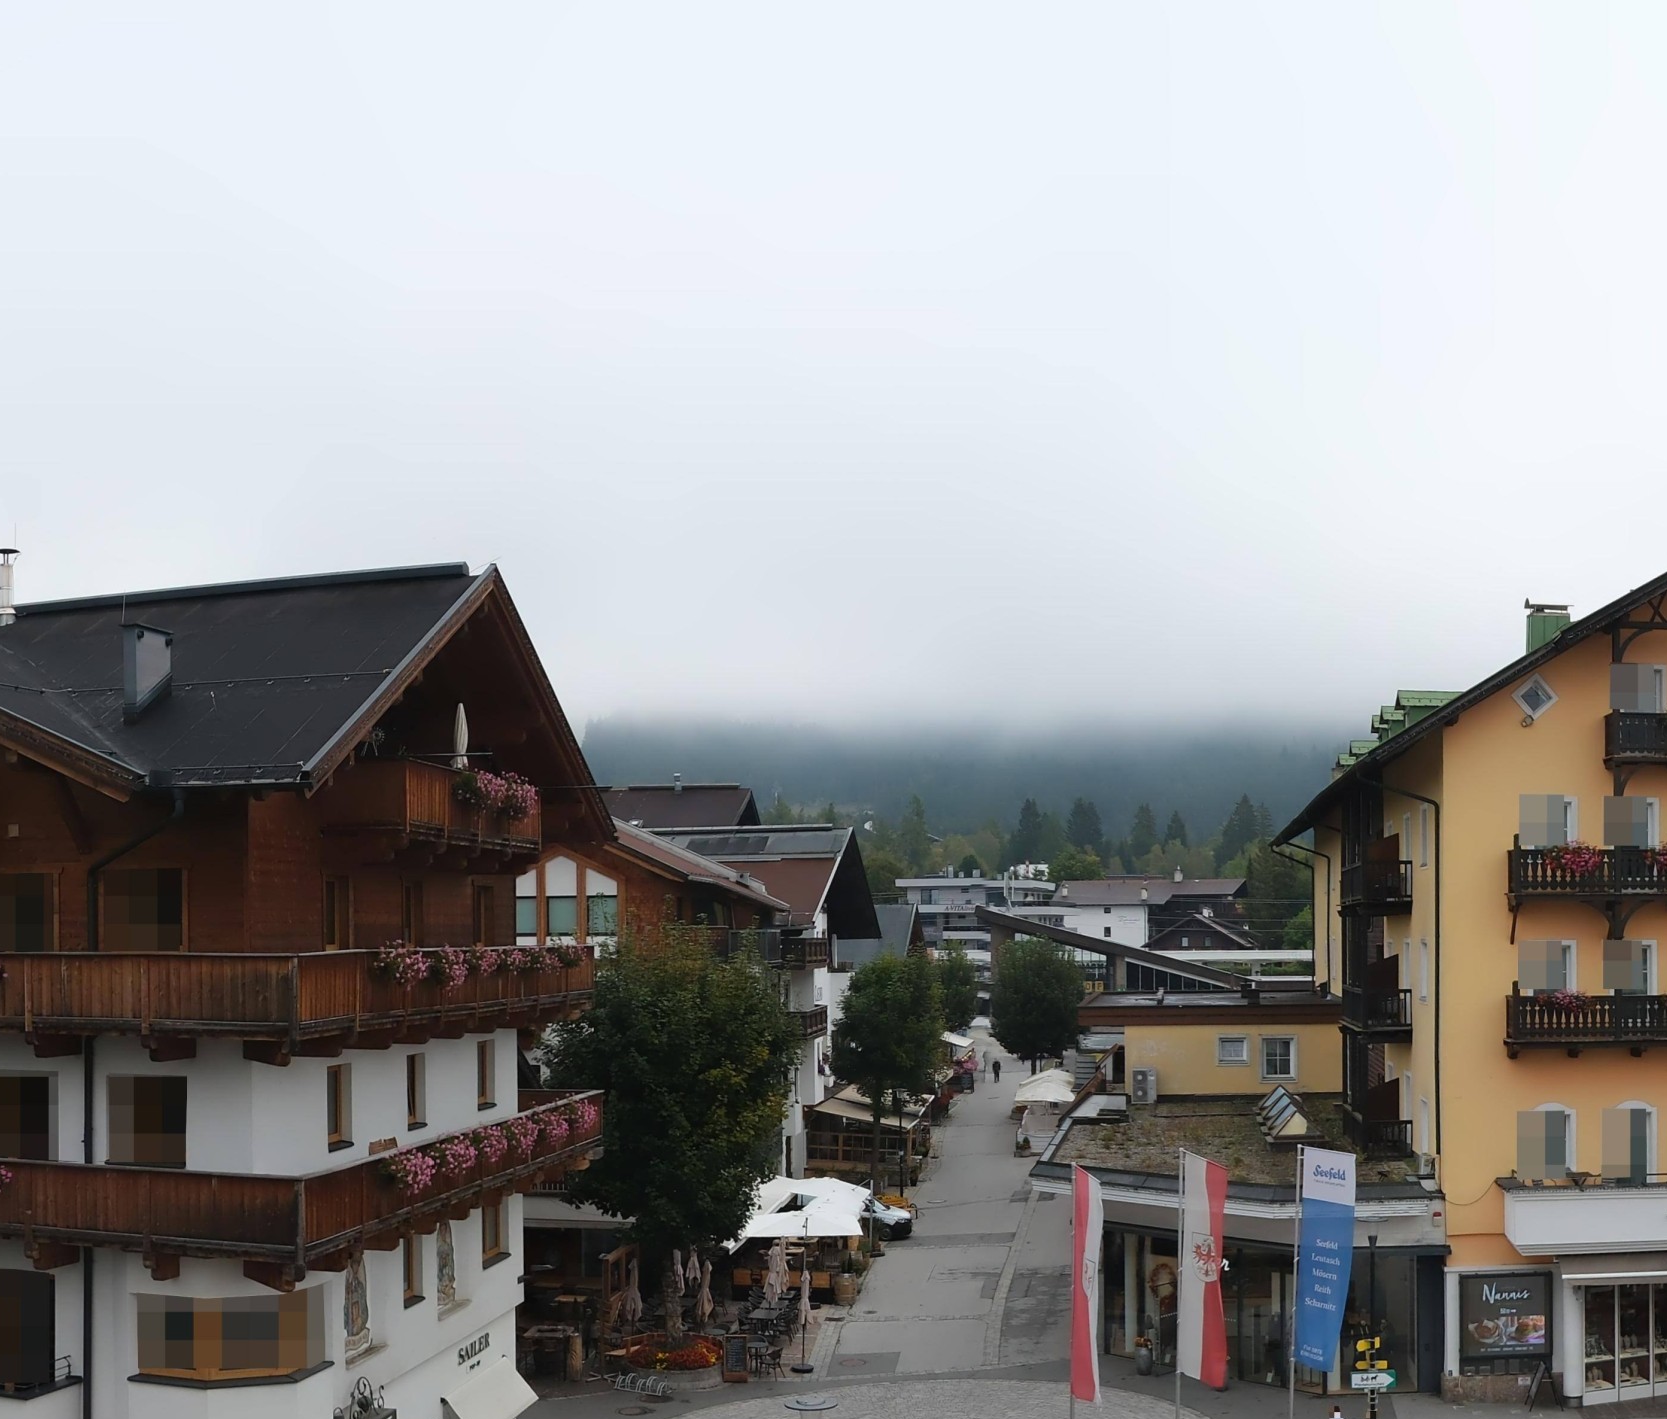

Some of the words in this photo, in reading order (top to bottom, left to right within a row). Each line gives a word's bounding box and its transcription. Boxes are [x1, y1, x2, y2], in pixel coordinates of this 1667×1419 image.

[1313, 1164, 1347, 1181] Seefeld
[1316, 1238, 1338, 1251] Seefeld
[1311, 1253, 1341, 1267] Leutasch
[1312, 1267, 1337, 1281] Mösern
[1314, 1283, 1331, 1295] Reith
[1482, 1281, 1530, 1304] Nannis
[1304, 1297, 1337, 1312] Scharnitz
[458, 1332, 490, 1366] SAILER
